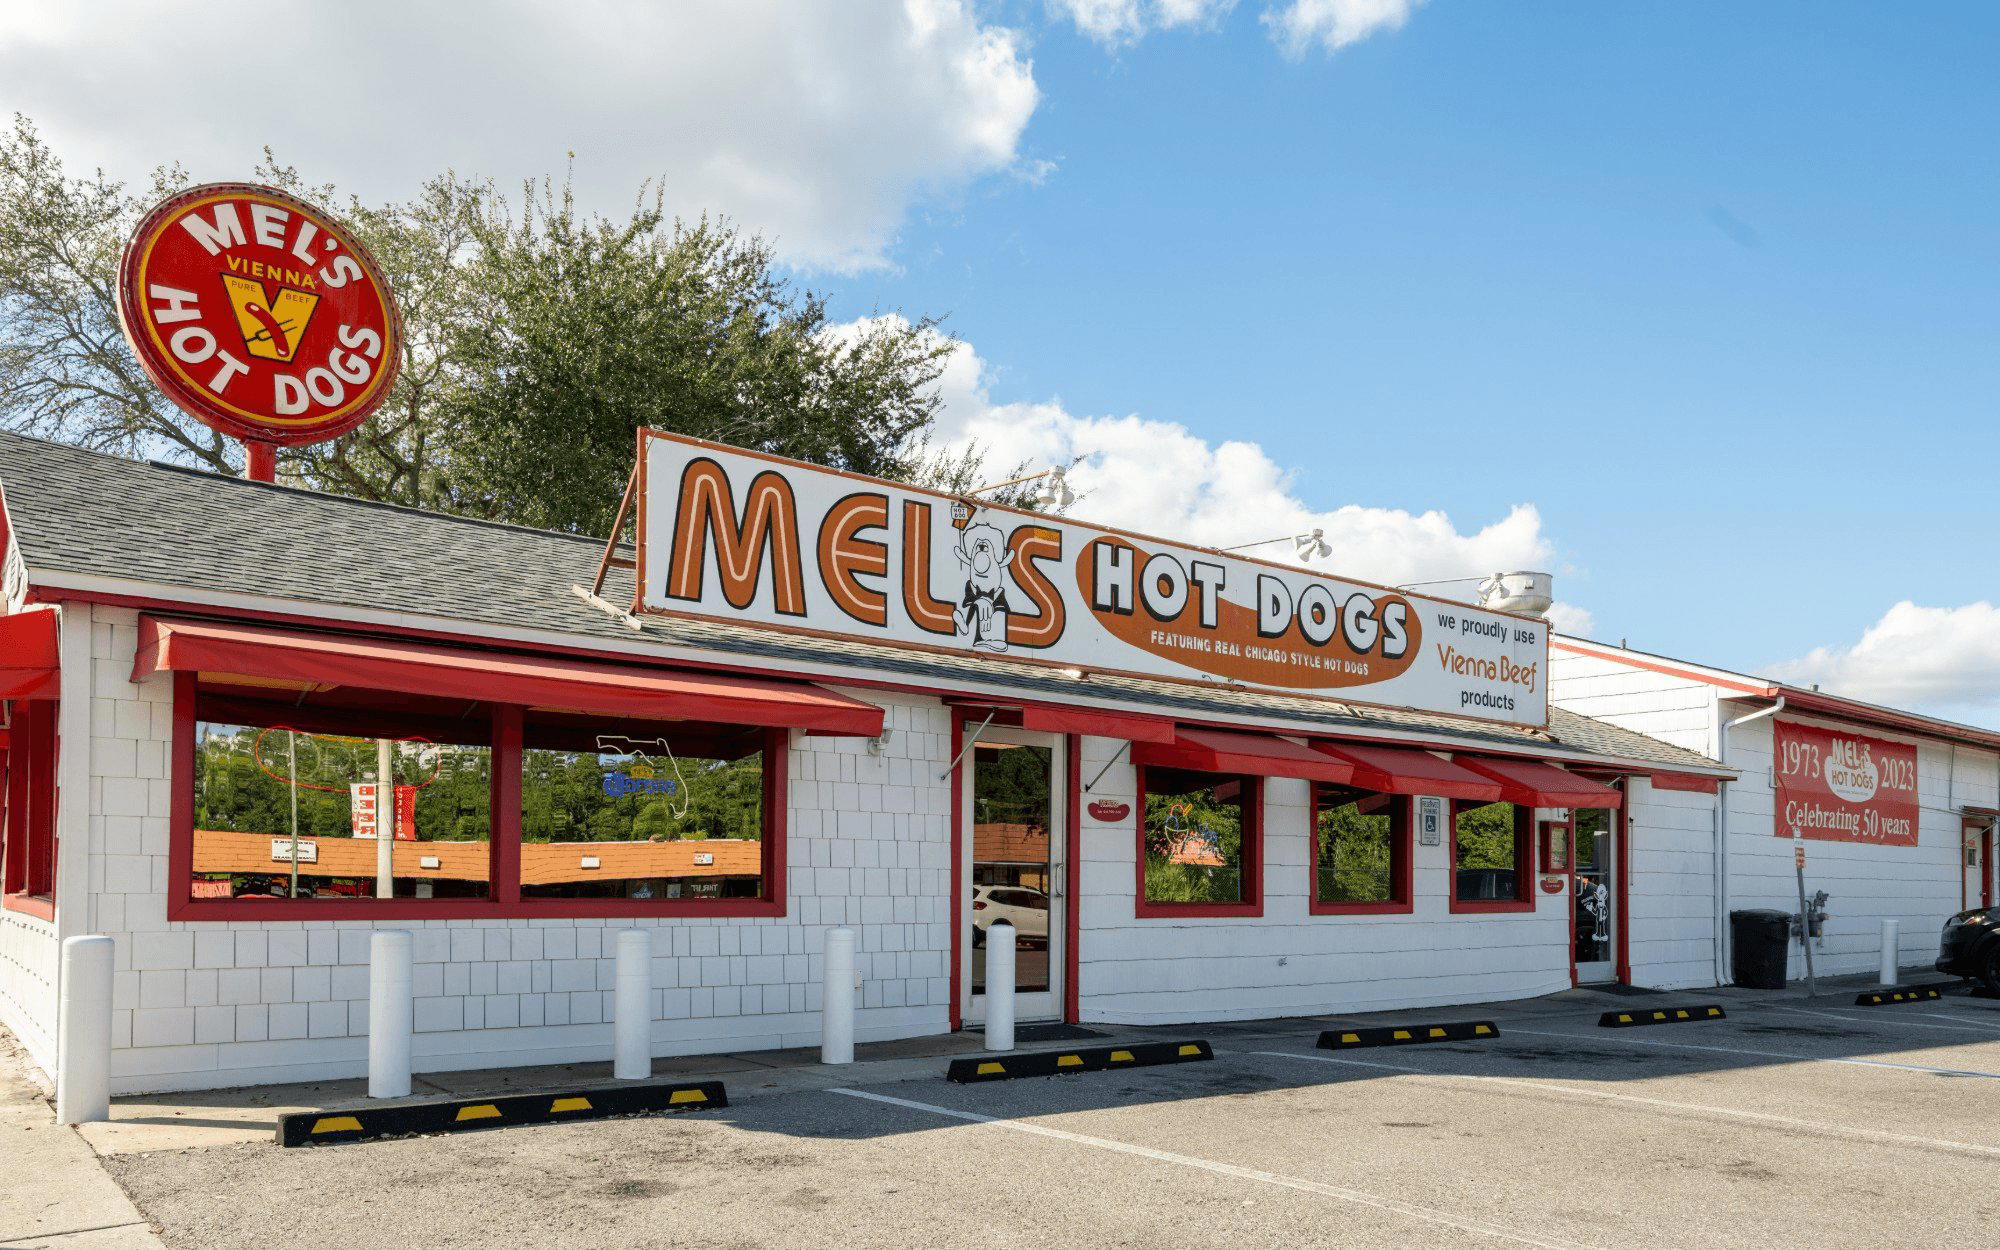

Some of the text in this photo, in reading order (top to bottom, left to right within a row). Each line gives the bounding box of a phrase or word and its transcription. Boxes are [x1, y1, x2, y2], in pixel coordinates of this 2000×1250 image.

[179, 203, 363, 288] MEL'S
[226, 254, 315, 290] VIENNA
[231, 280, 256, 293] PURE
[285, 293, 310, 304] BEEF
[150, 284, 381, 415] HOT DOGS
[1092, 541, 1225, 629] HOT
[1257, 574, 1408, 659] DOGS
[1437, 614, 1535, 644] we proudly use
[1151, 630, 1369, 676] FEATURING REAL CHICAGO STYLE HOT DOGS
[1437, 643, 1537, 693] Vienna Beef
[1461, 690, 1514, 710] products
[1781, 739, 1819, 778] 1973
[1880, 757, 1914, 791] 2023
[1831, 769, 1873, 789] HOT DOGS
[1786, 801, 1910, 838] Celebrating 50 years
